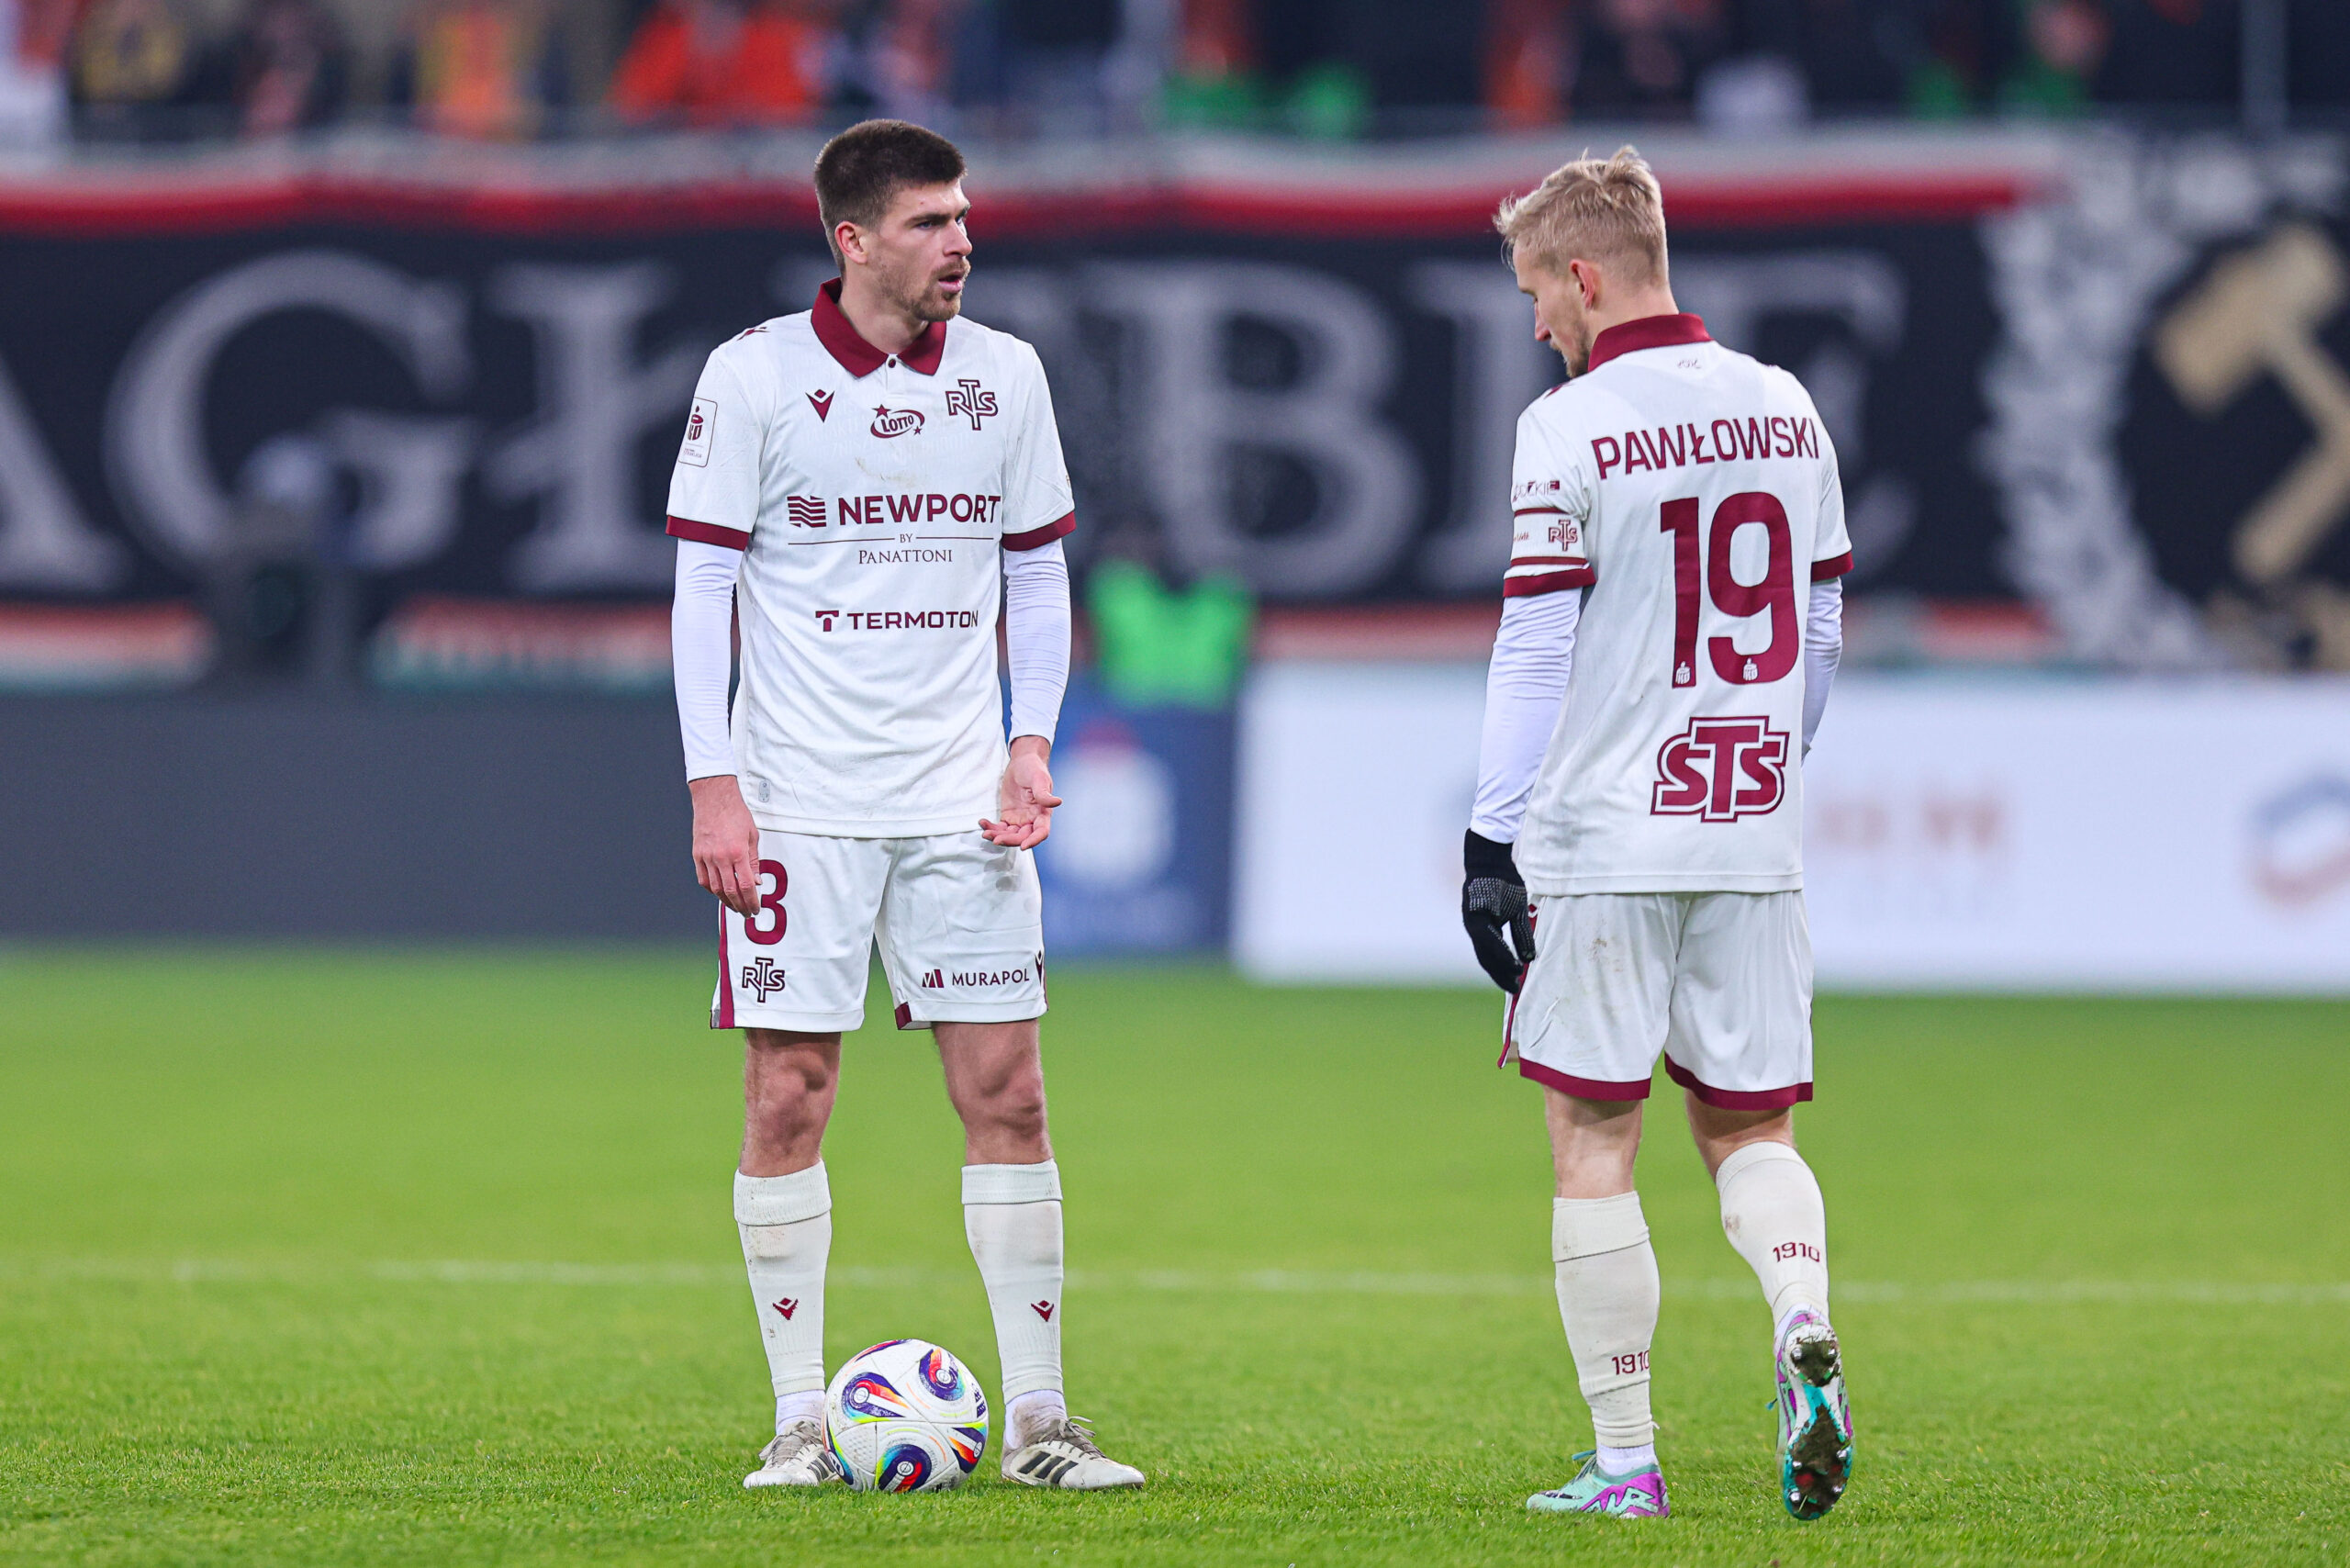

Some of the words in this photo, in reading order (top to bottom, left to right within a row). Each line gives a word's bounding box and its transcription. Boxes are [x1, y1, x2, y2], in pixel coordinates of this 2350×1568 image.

[880, 414, 914, 433] LOTTO
[1591, 417, 1819, 480] PAWŁOWSKI
[838, 493, 1002, 526] NEWPORT
[900, 533, 913, 543] BY
[858, 549, 952, 564] PANATTONI
[1660, 491, 1800, 689] 19
[846, 610, 979, 630] TERMOTON
[1651, 715, 1790, 823] STS
[952, 968, 1030, 987] MURAPOL
[1773, 1241, 1820, 1263] 1910
[1611, 1350, 1650, 1375] 1910
